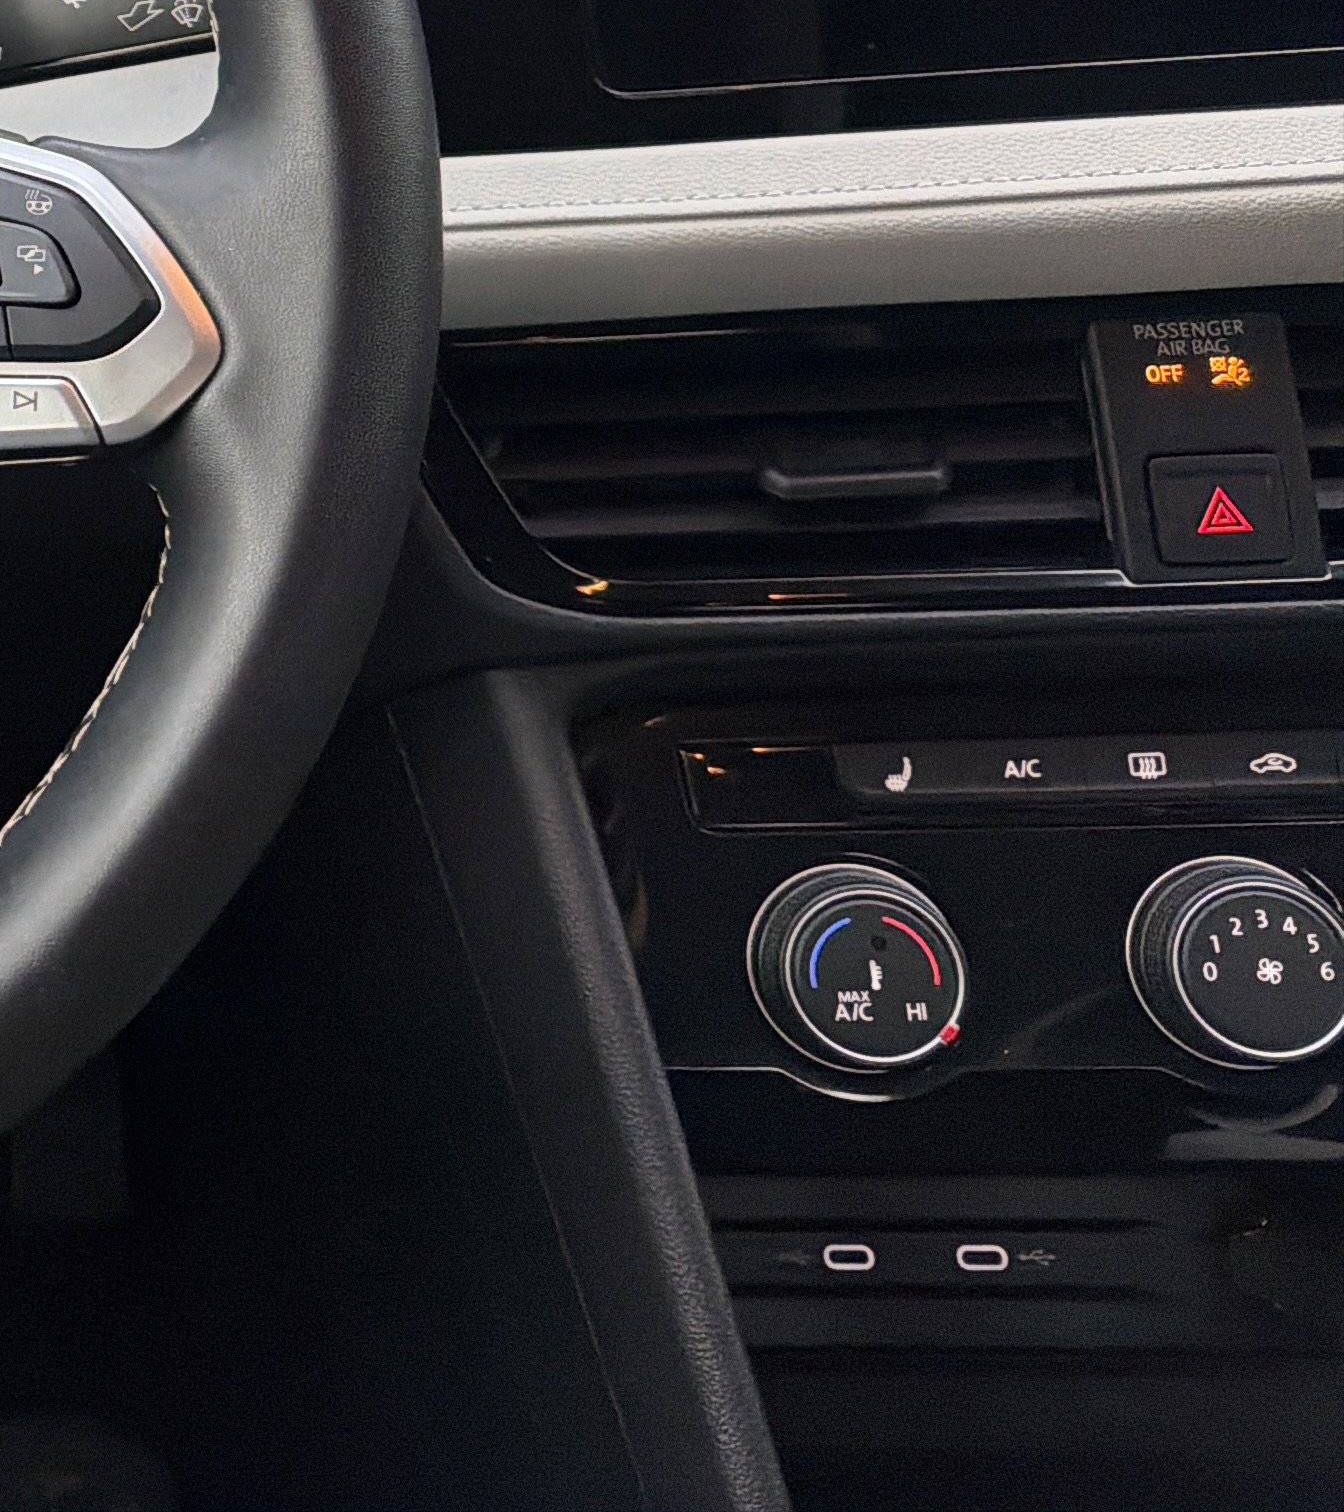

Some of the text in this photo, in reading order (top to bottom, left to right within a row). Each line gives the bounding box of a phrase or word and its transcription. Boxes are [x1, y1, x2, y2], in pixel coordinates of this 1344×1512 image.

[1132, 319, 1245, 340] PASSENGER
[1156, 338, 1231, 357] AIR BAG
[1145, 364, 1184, 383] OFF
[1003, 758, 1042, 779] A/C
[1209, 934, 1221, 954] 1
[1228, 917, 1244, 936] 2
[1254, 908, 1269, 929] 3
[1282, 916, 1297, 936] 4
[1306, 933, 1320, 953] 5
[1320, 961, 1336, 981] 6
[837, 990, 871, 1003] MAX
[834, 1002, 874, 1022] A/C
[905, 1002, 928, 1022] HI
